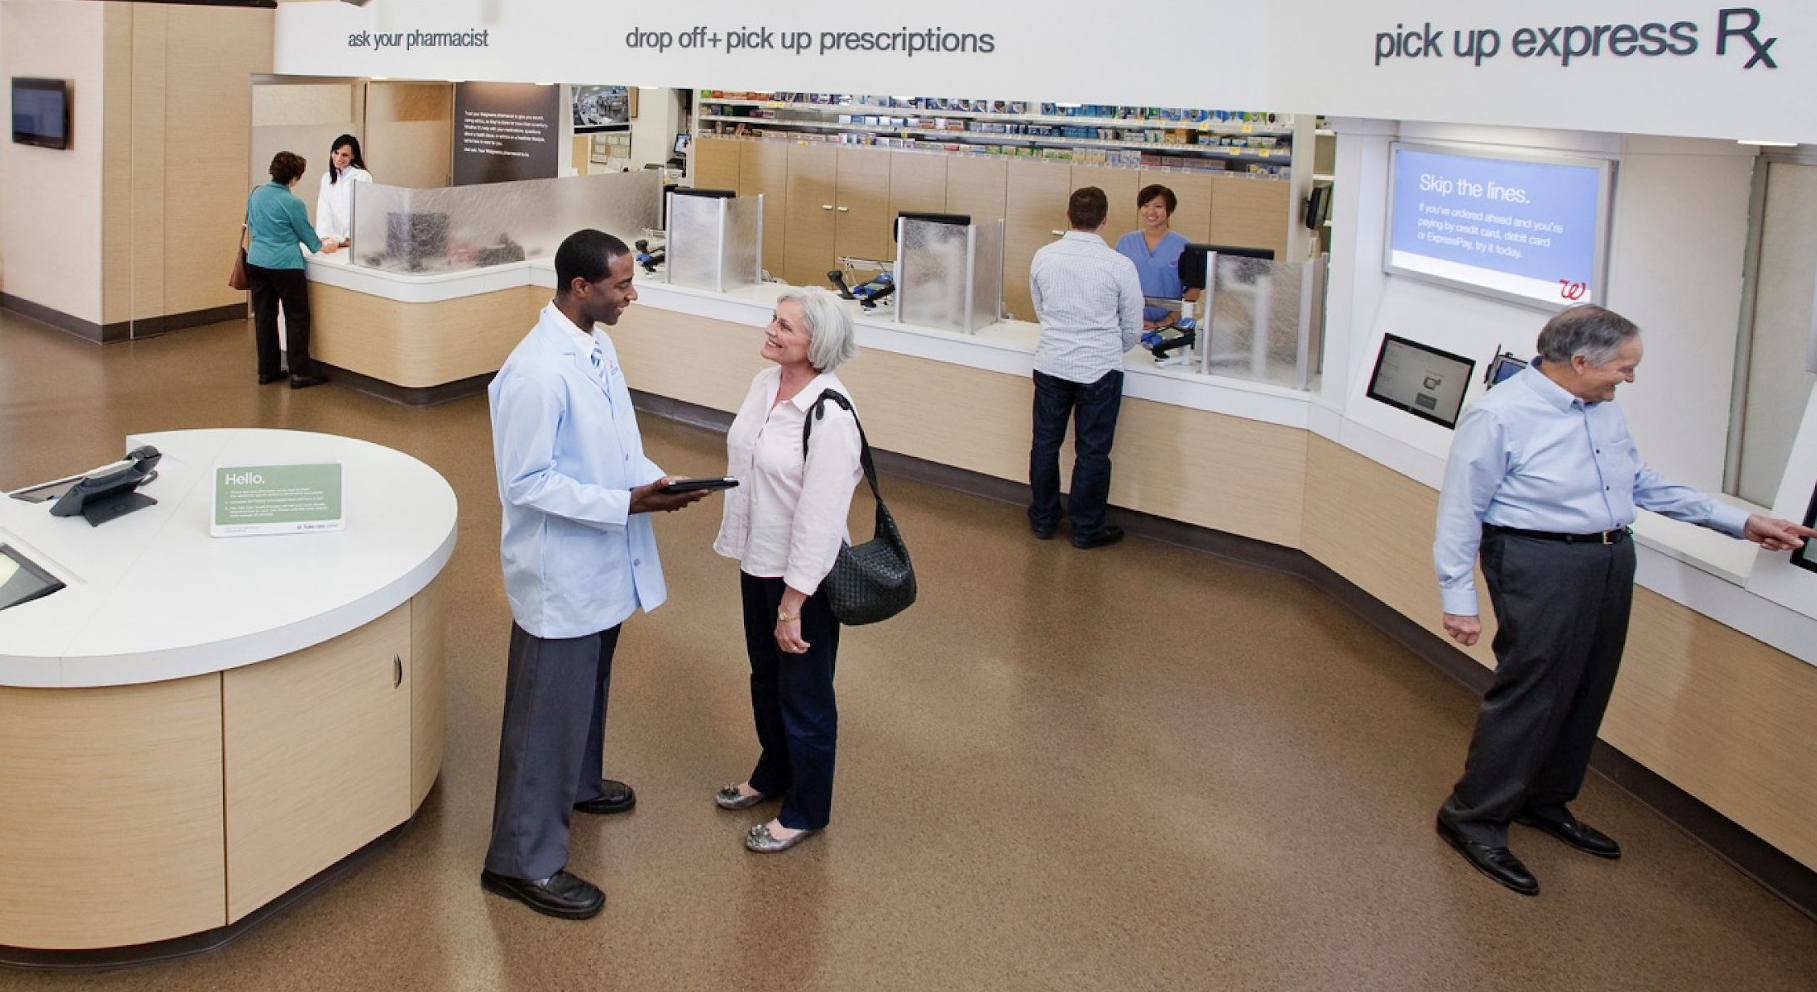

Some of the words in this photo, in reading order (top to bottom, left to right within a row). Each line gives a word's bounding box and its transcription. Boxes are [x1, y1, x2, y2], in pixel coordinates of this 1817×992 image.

[348, 30, 371, 47] ask
[374, 33, 403, 51] your
[406, 28, 489, 51] pharmacist
[625, 27, 672, 53] drop
[726, 27, 774, 54] pick
[781, 31, 812, 55] up
[819, 27, 995, 57] prescriptions
[1375, 23, 1443, 66] pick
[1454, 27, 1501, 66] up
[1512, 20, 1699, 67] express
[1716, 6, 1779, 70] Rx
[1419, 173, 1452, 197] Skip
[1457, 178, 1483, 198] the
[1487, 181, 1531, 204] lines.
[1417, 217, 1443, 232] paying
[1444, 221, 1455, 233] by
[1456, 222, 1479, 236] credit
[1480, 227, 1502, 241] card,
[1505, 231, 1527, 244] debit
[1529, 235, 1551, 247] card
[1425, 203, 1451, 216] you've
[1451, 206, 1483, 221] ordered
[1484, 211, 1512, 226] ahead
[1514, 216, 1532, 229] and
[1533, 220, 1563, 234] you're
[1417, 232, 1426, 240] or
[1475, 240, 1487, 253] try
[1488, 242, 1495, 252] it
[1496, 245, 1522, 259] today.
[225, 471, 265, 486] Hello.
